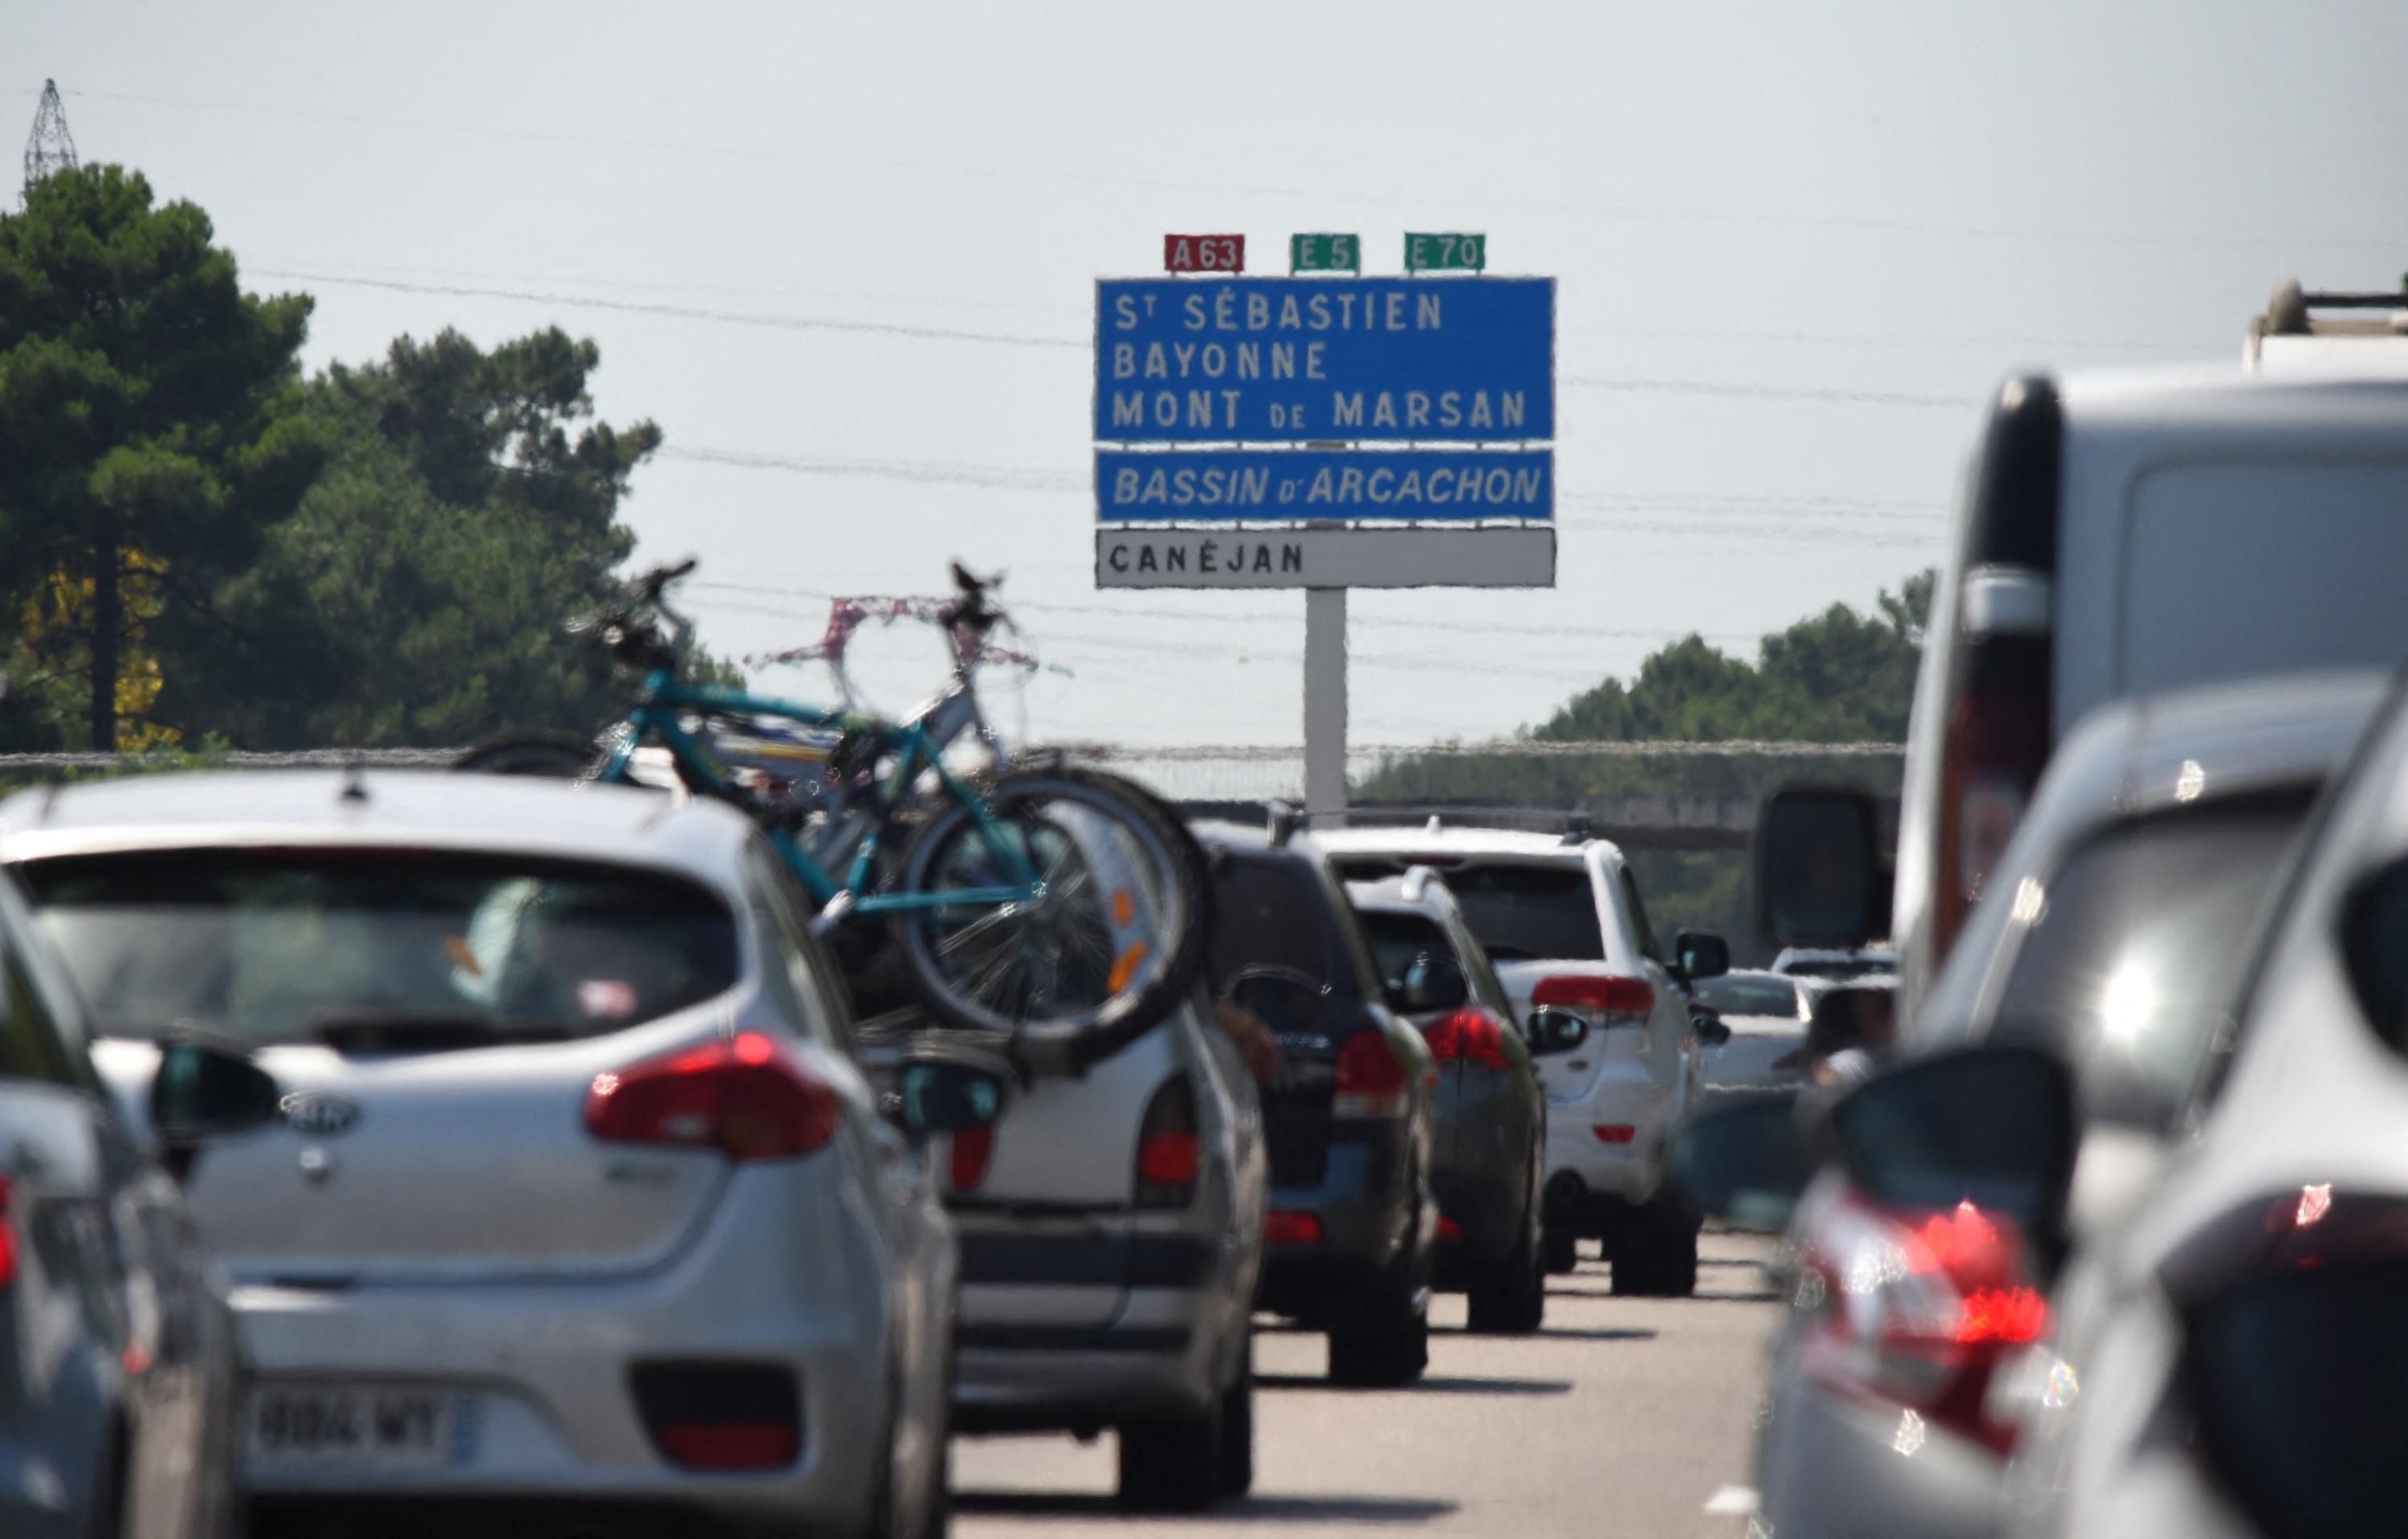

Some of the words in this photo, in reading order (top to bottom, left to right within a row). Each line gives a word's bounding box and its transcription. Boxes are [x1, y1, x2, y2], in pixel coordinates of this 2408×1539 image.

[1301, 238, 1316, 267] E
[1331, 238, 1349, 267] 5
[1412, 238, 1426, 267] E
[1438, 238, 1478, 267] 70
[1186, 287, 1440, 330] SÉBASTIEN
[1115, 343, 1324, 378] BAYONNE
[1114, 391, 1239, 427] MONT
[1271, 405, 1302, 427] DE
[1335, 392, 1523, 427] MARSAN
[1115, 469, 1268, 503] BASSIN
[1109, 540, 1301, 573] CANÉJAN
